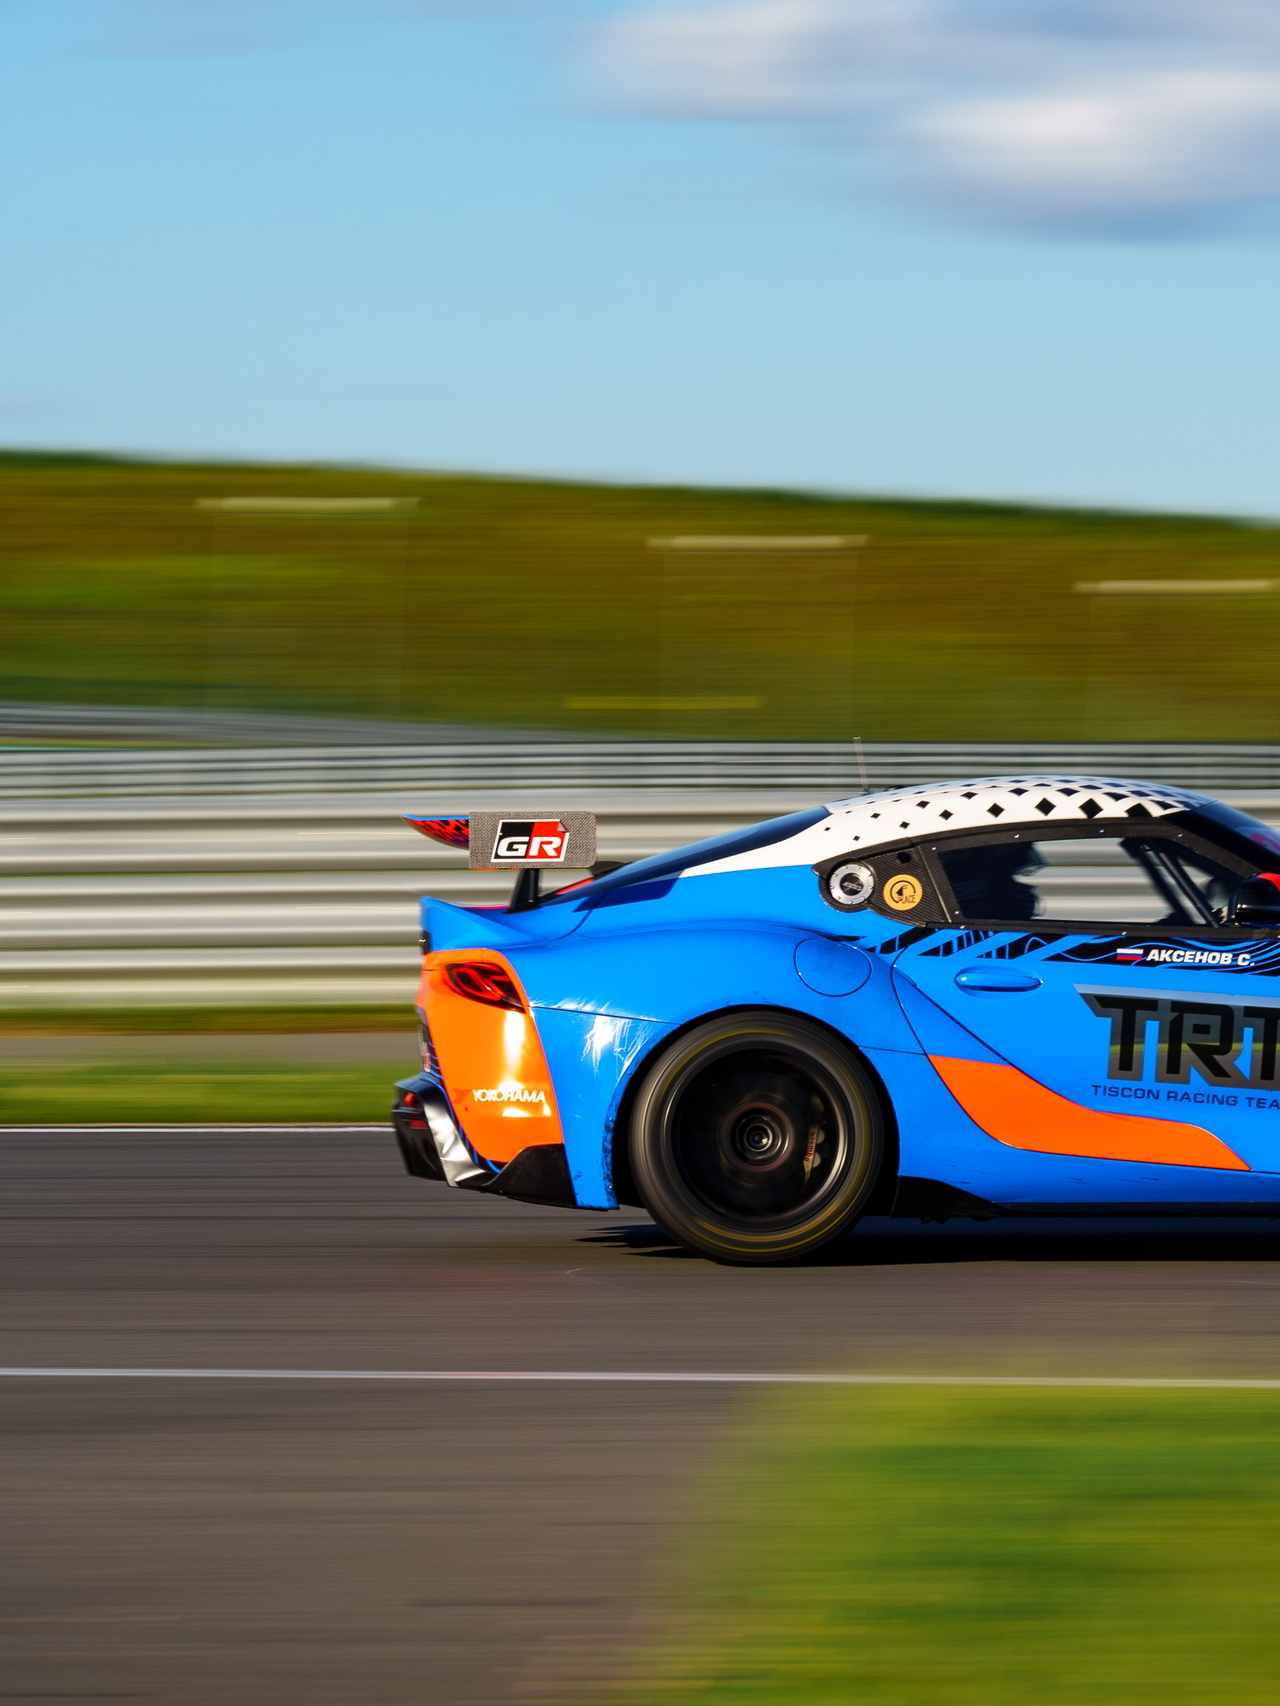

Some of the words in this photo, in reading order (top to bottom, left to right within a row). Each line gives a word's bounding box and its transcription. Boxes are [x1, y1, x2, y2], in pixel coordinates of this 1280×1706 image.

[497, 836, 562, 857] GR
[1146, 949, 1233, 965] АКСЕНОВ
[1237, 953, 1255, 966] С.
[472, 1089, 546, 1104] YOKOHAMA
[1091, 1085, 1160, 1100] TISCON
[1166, 1090, 1238, 1106] RACING
